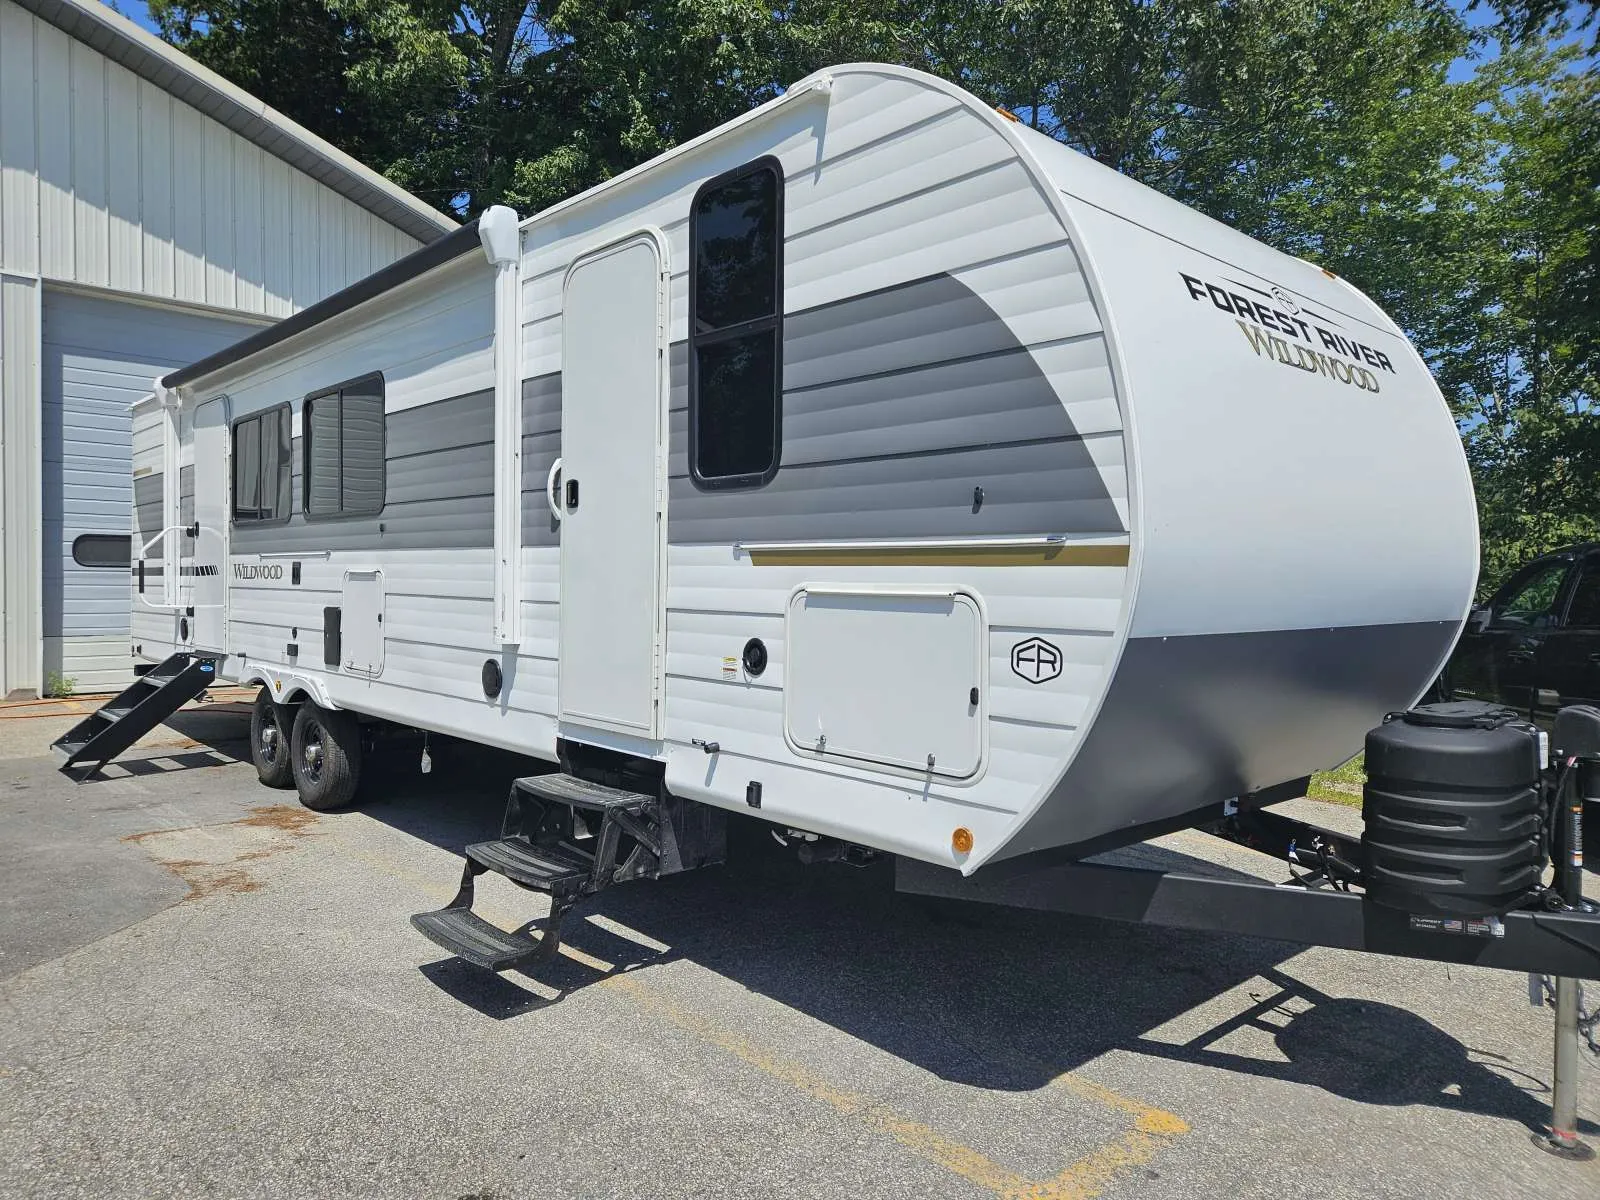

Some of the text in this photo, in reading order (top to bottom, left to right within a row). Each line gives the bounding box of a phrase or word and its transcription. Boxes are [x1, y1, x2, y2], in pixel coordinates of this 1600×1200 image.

[1178, 271, 1397, 375] FOREST RIVER
[1235, 318, 1380, 394] WILDWOOD
[233, 563, 283, 580] WILDWOOD
